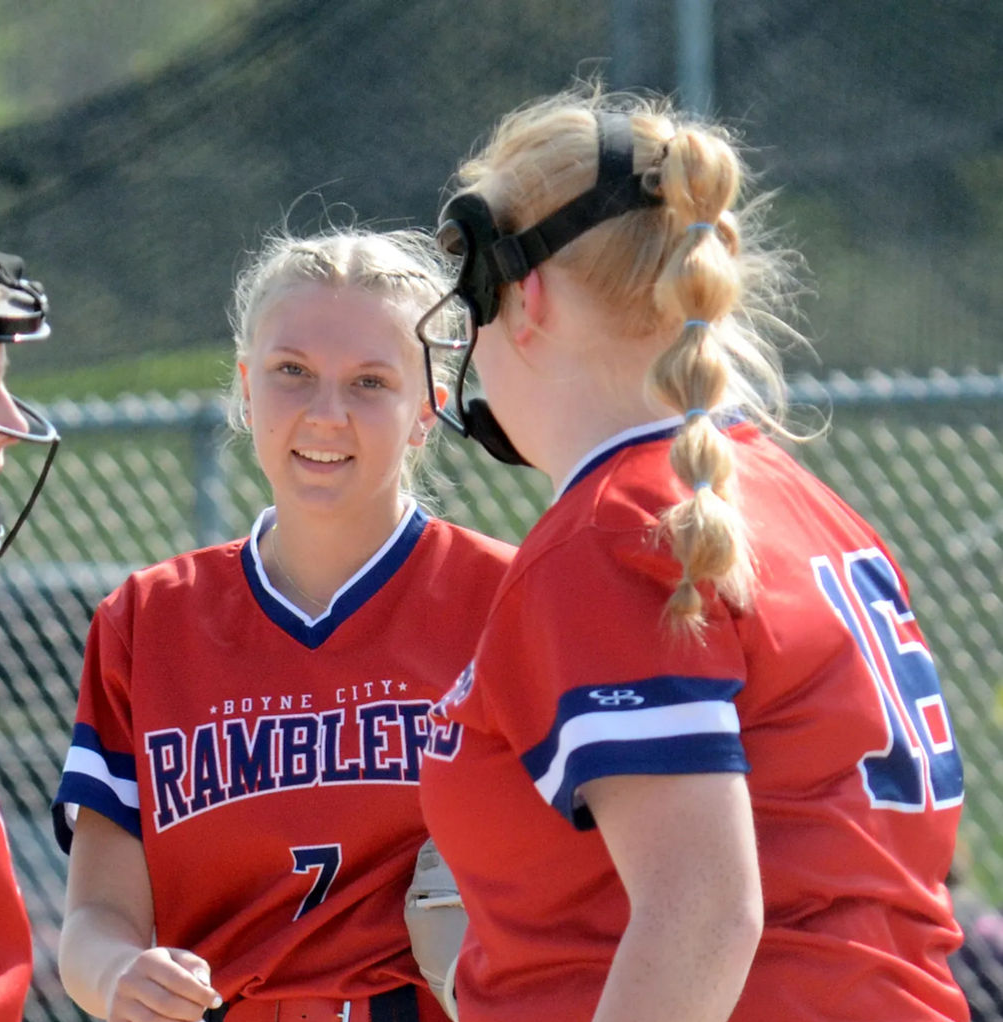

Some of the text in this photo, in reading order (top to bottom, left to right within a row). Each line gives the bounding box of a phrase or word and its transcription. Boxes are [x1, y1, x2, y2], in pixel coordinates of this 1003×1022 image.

[223, 679, 393, 715] BOYNE CITY
[811, 547, 964, 813] 16
[289, 843, 342, 922] 7
